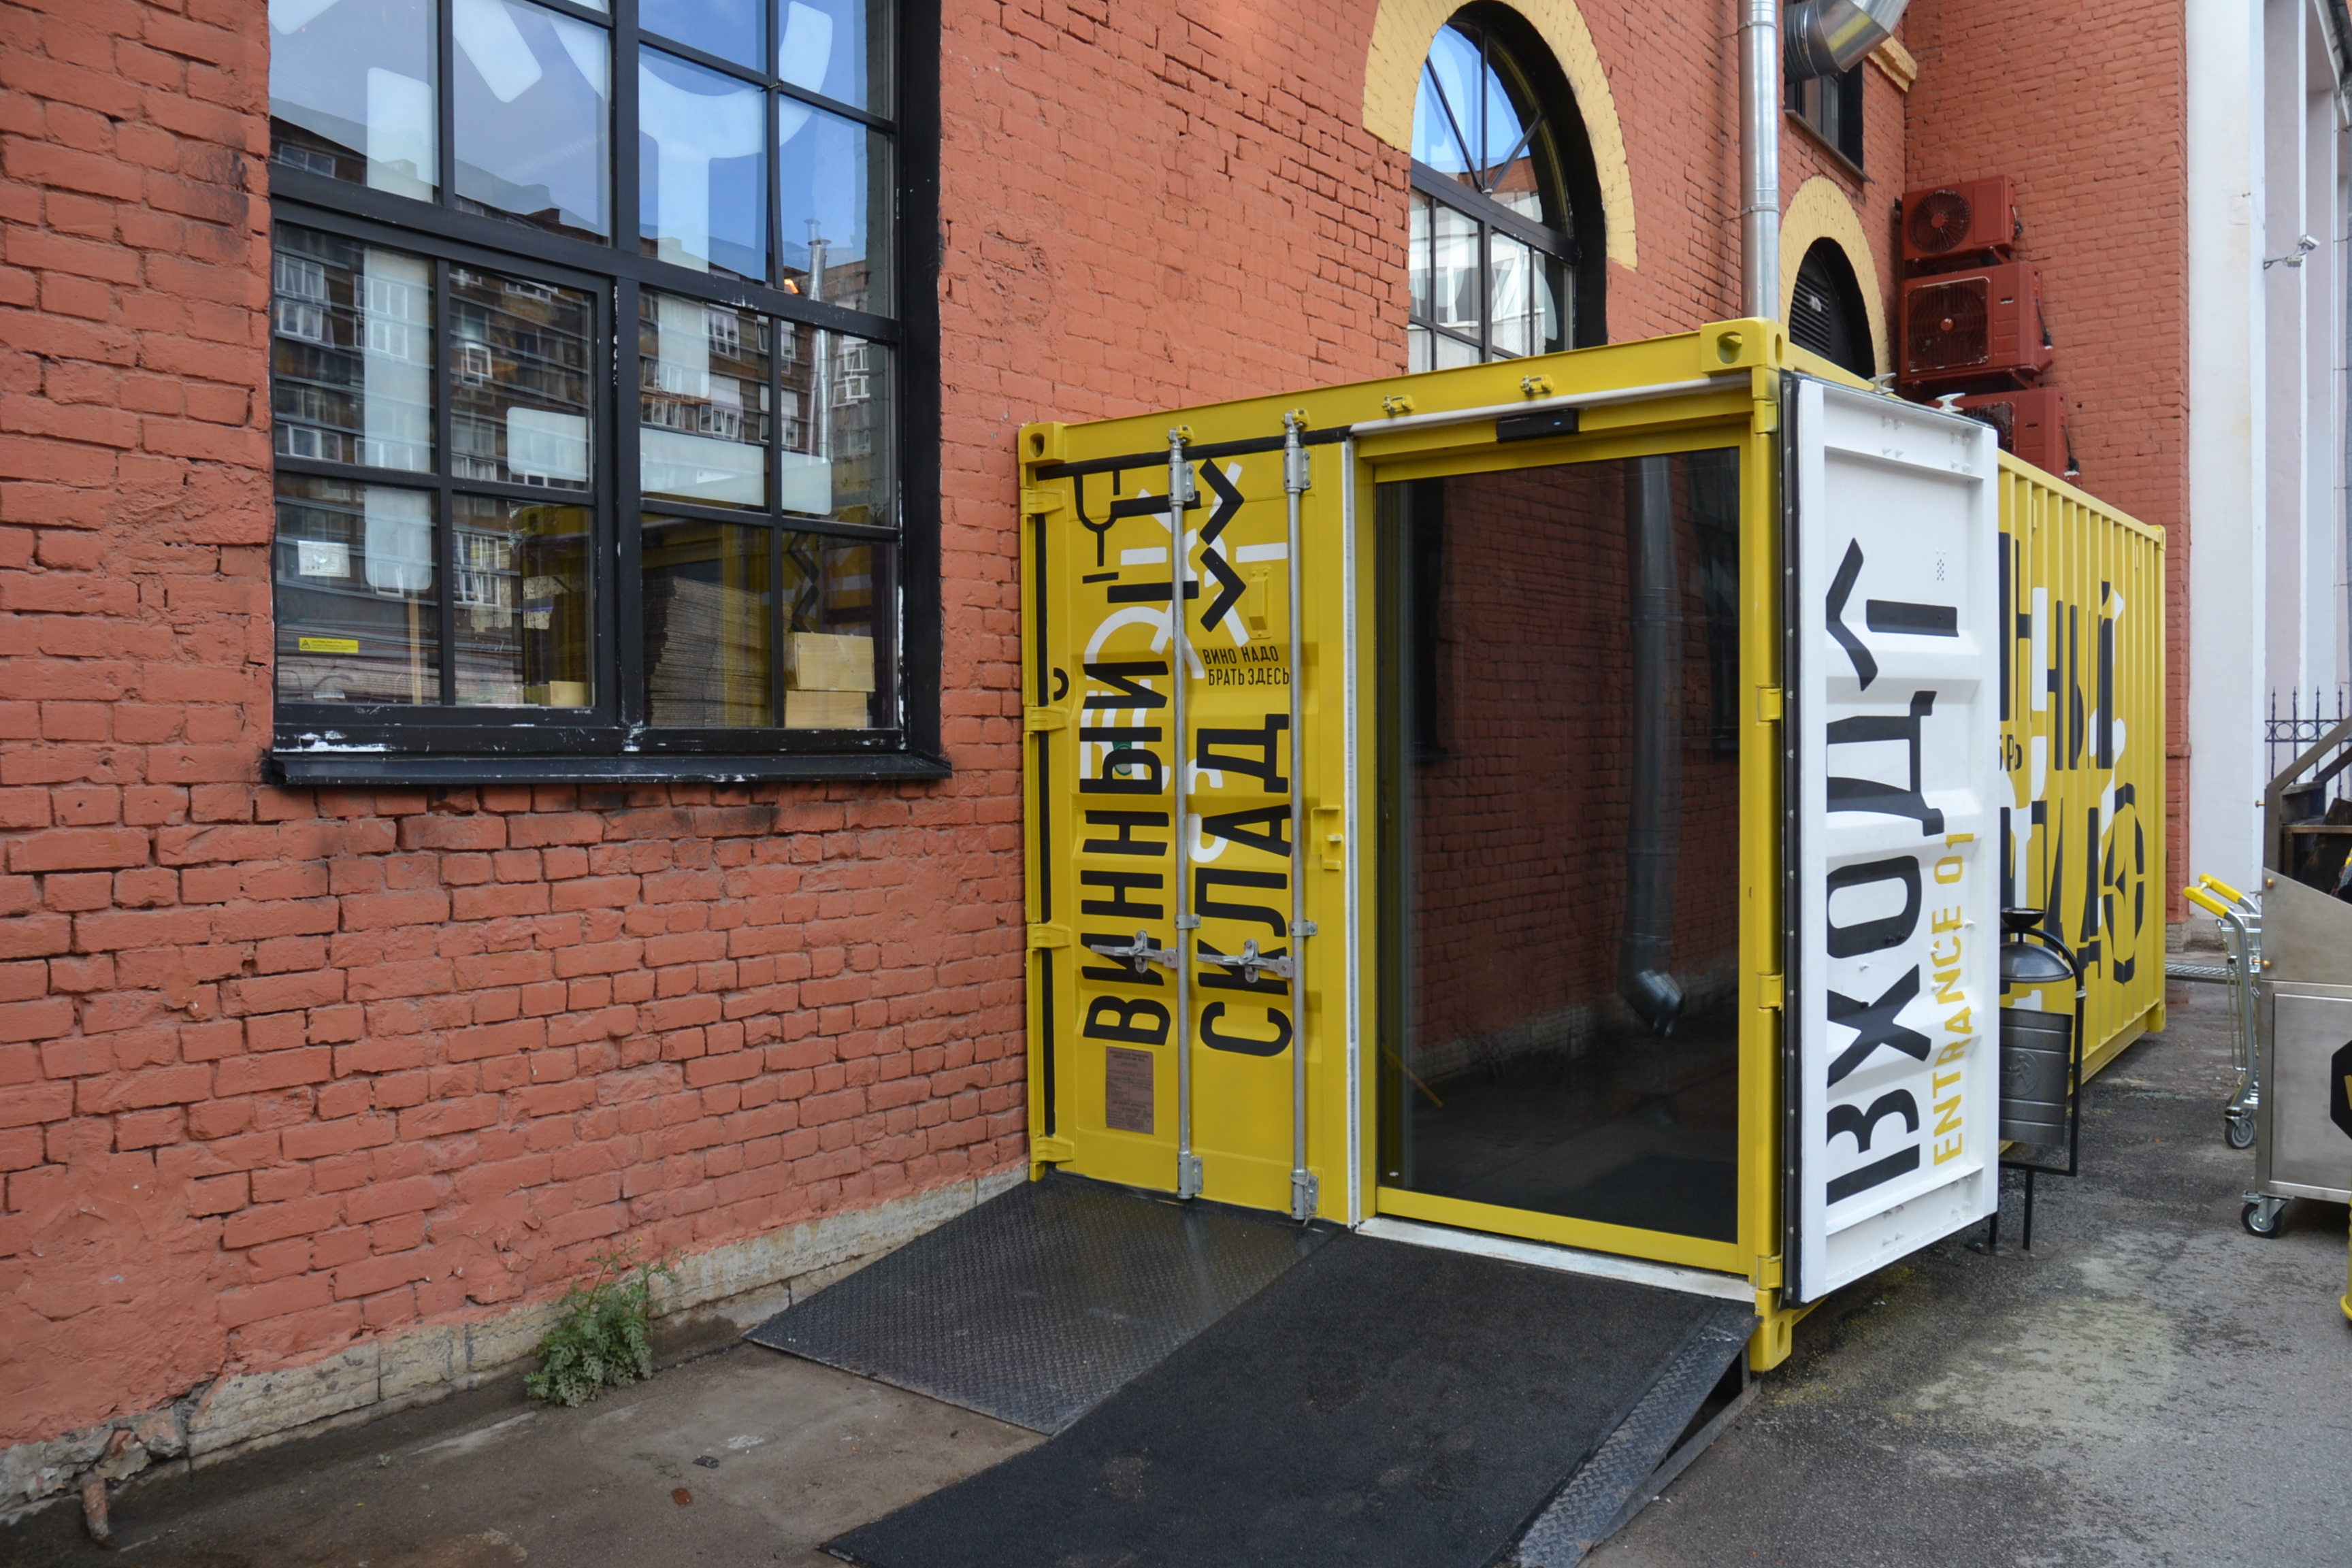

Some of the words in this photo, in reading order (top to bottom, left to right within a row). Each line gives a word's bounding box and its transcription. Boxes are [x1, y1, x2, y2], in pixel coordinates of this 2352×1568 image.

[1203, 648, 1237, 664] ВИНО
[1241, 646, 1279, 663] НАДО
[1208, 668, 1245, 686] БРАТЬ
[1247, 667, 1290, 685] ЗДЕСЬ
[1054, 660, 1171, 1046] ВИННЫЙ
[1194, 713, 1292, 1057] СКЛАД
[1827, 690, 1945, 1207] ВХОД
[1934, 832, 1974, 885] 01
[1930, 905, 1974, 1166] ENTRANCE
